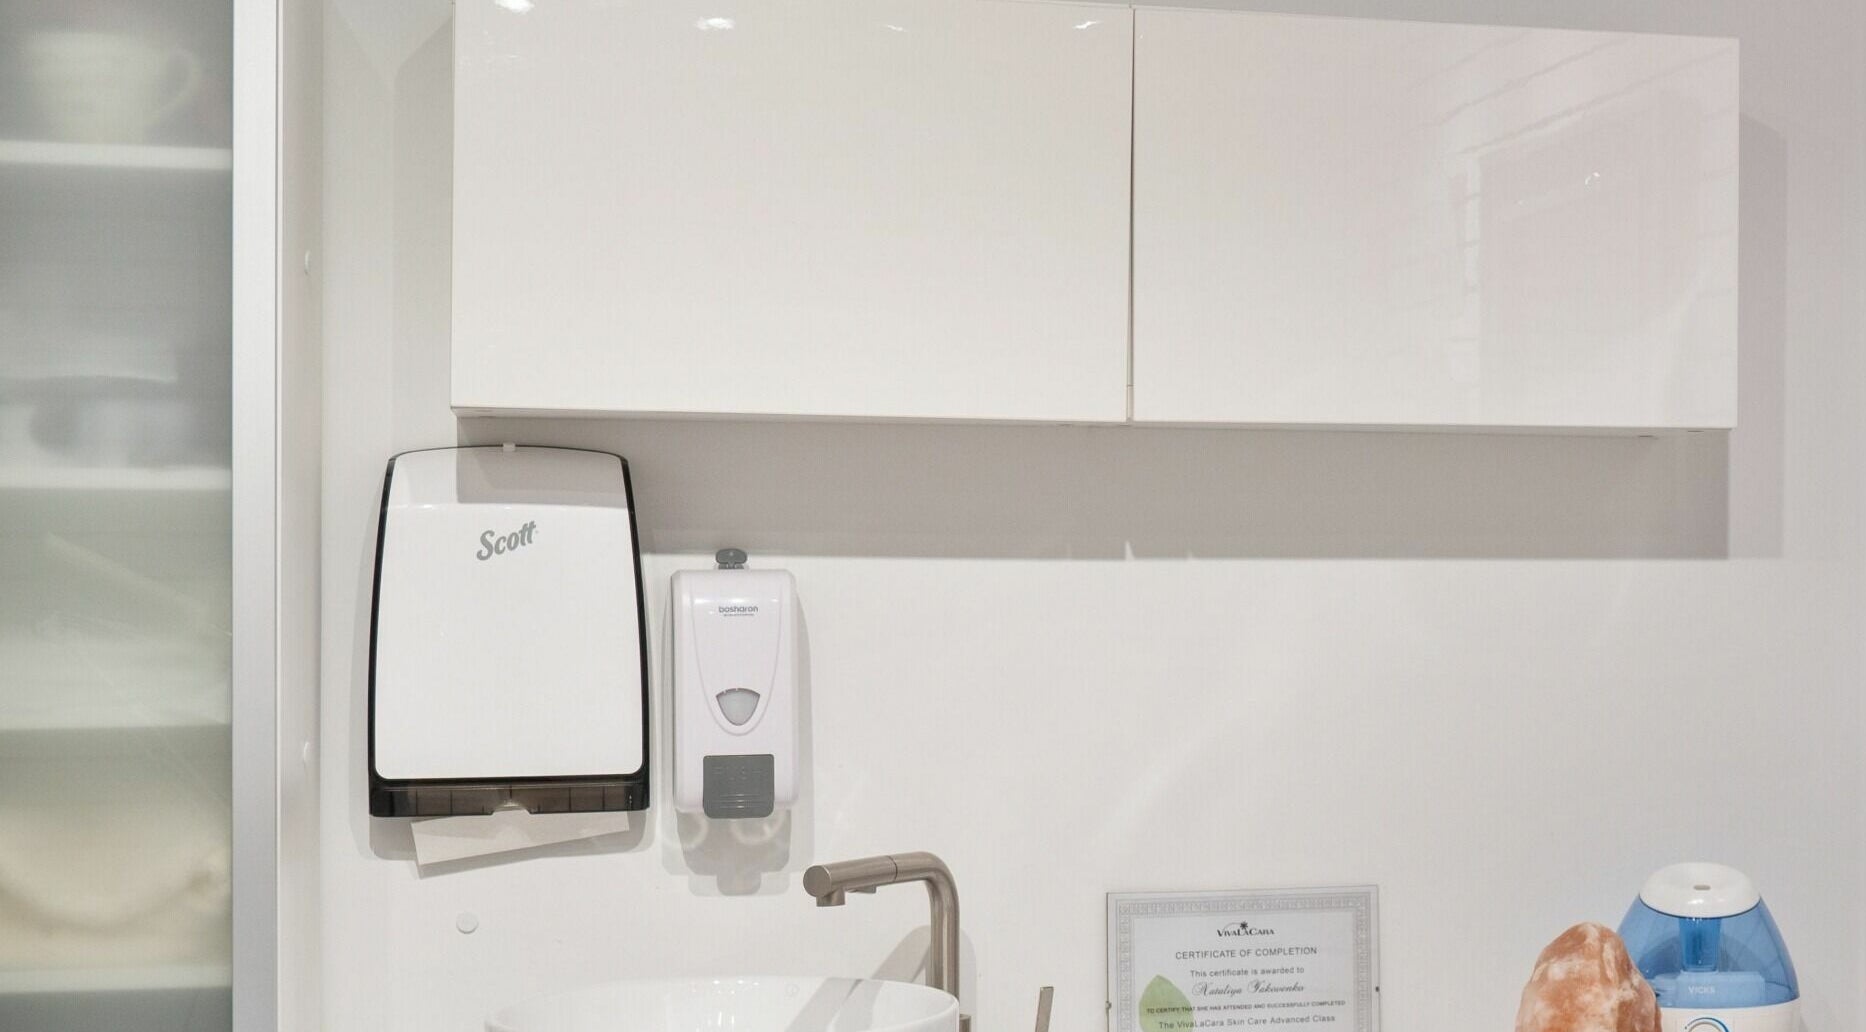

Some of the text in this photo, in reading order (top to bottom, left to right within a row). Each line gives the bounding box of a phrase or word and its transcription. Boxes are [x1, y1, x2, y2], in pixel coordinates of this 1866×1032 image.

[476, 520, 537, 561] Scott
[1175, 946, 1317, 960] CERTIFICATE OF COMPLETION
[1190, 966, 1304, 978] This certificate is awarded to
[1159, 1021, 1174, 1029] The
[1226, 1018, 1245, 1026] Skin
[1247, 1017, 1267, 1025] Care
[1270, 1015, 1310, 1024] Advanced
[1312, 1014, 1335, 1022] Class
